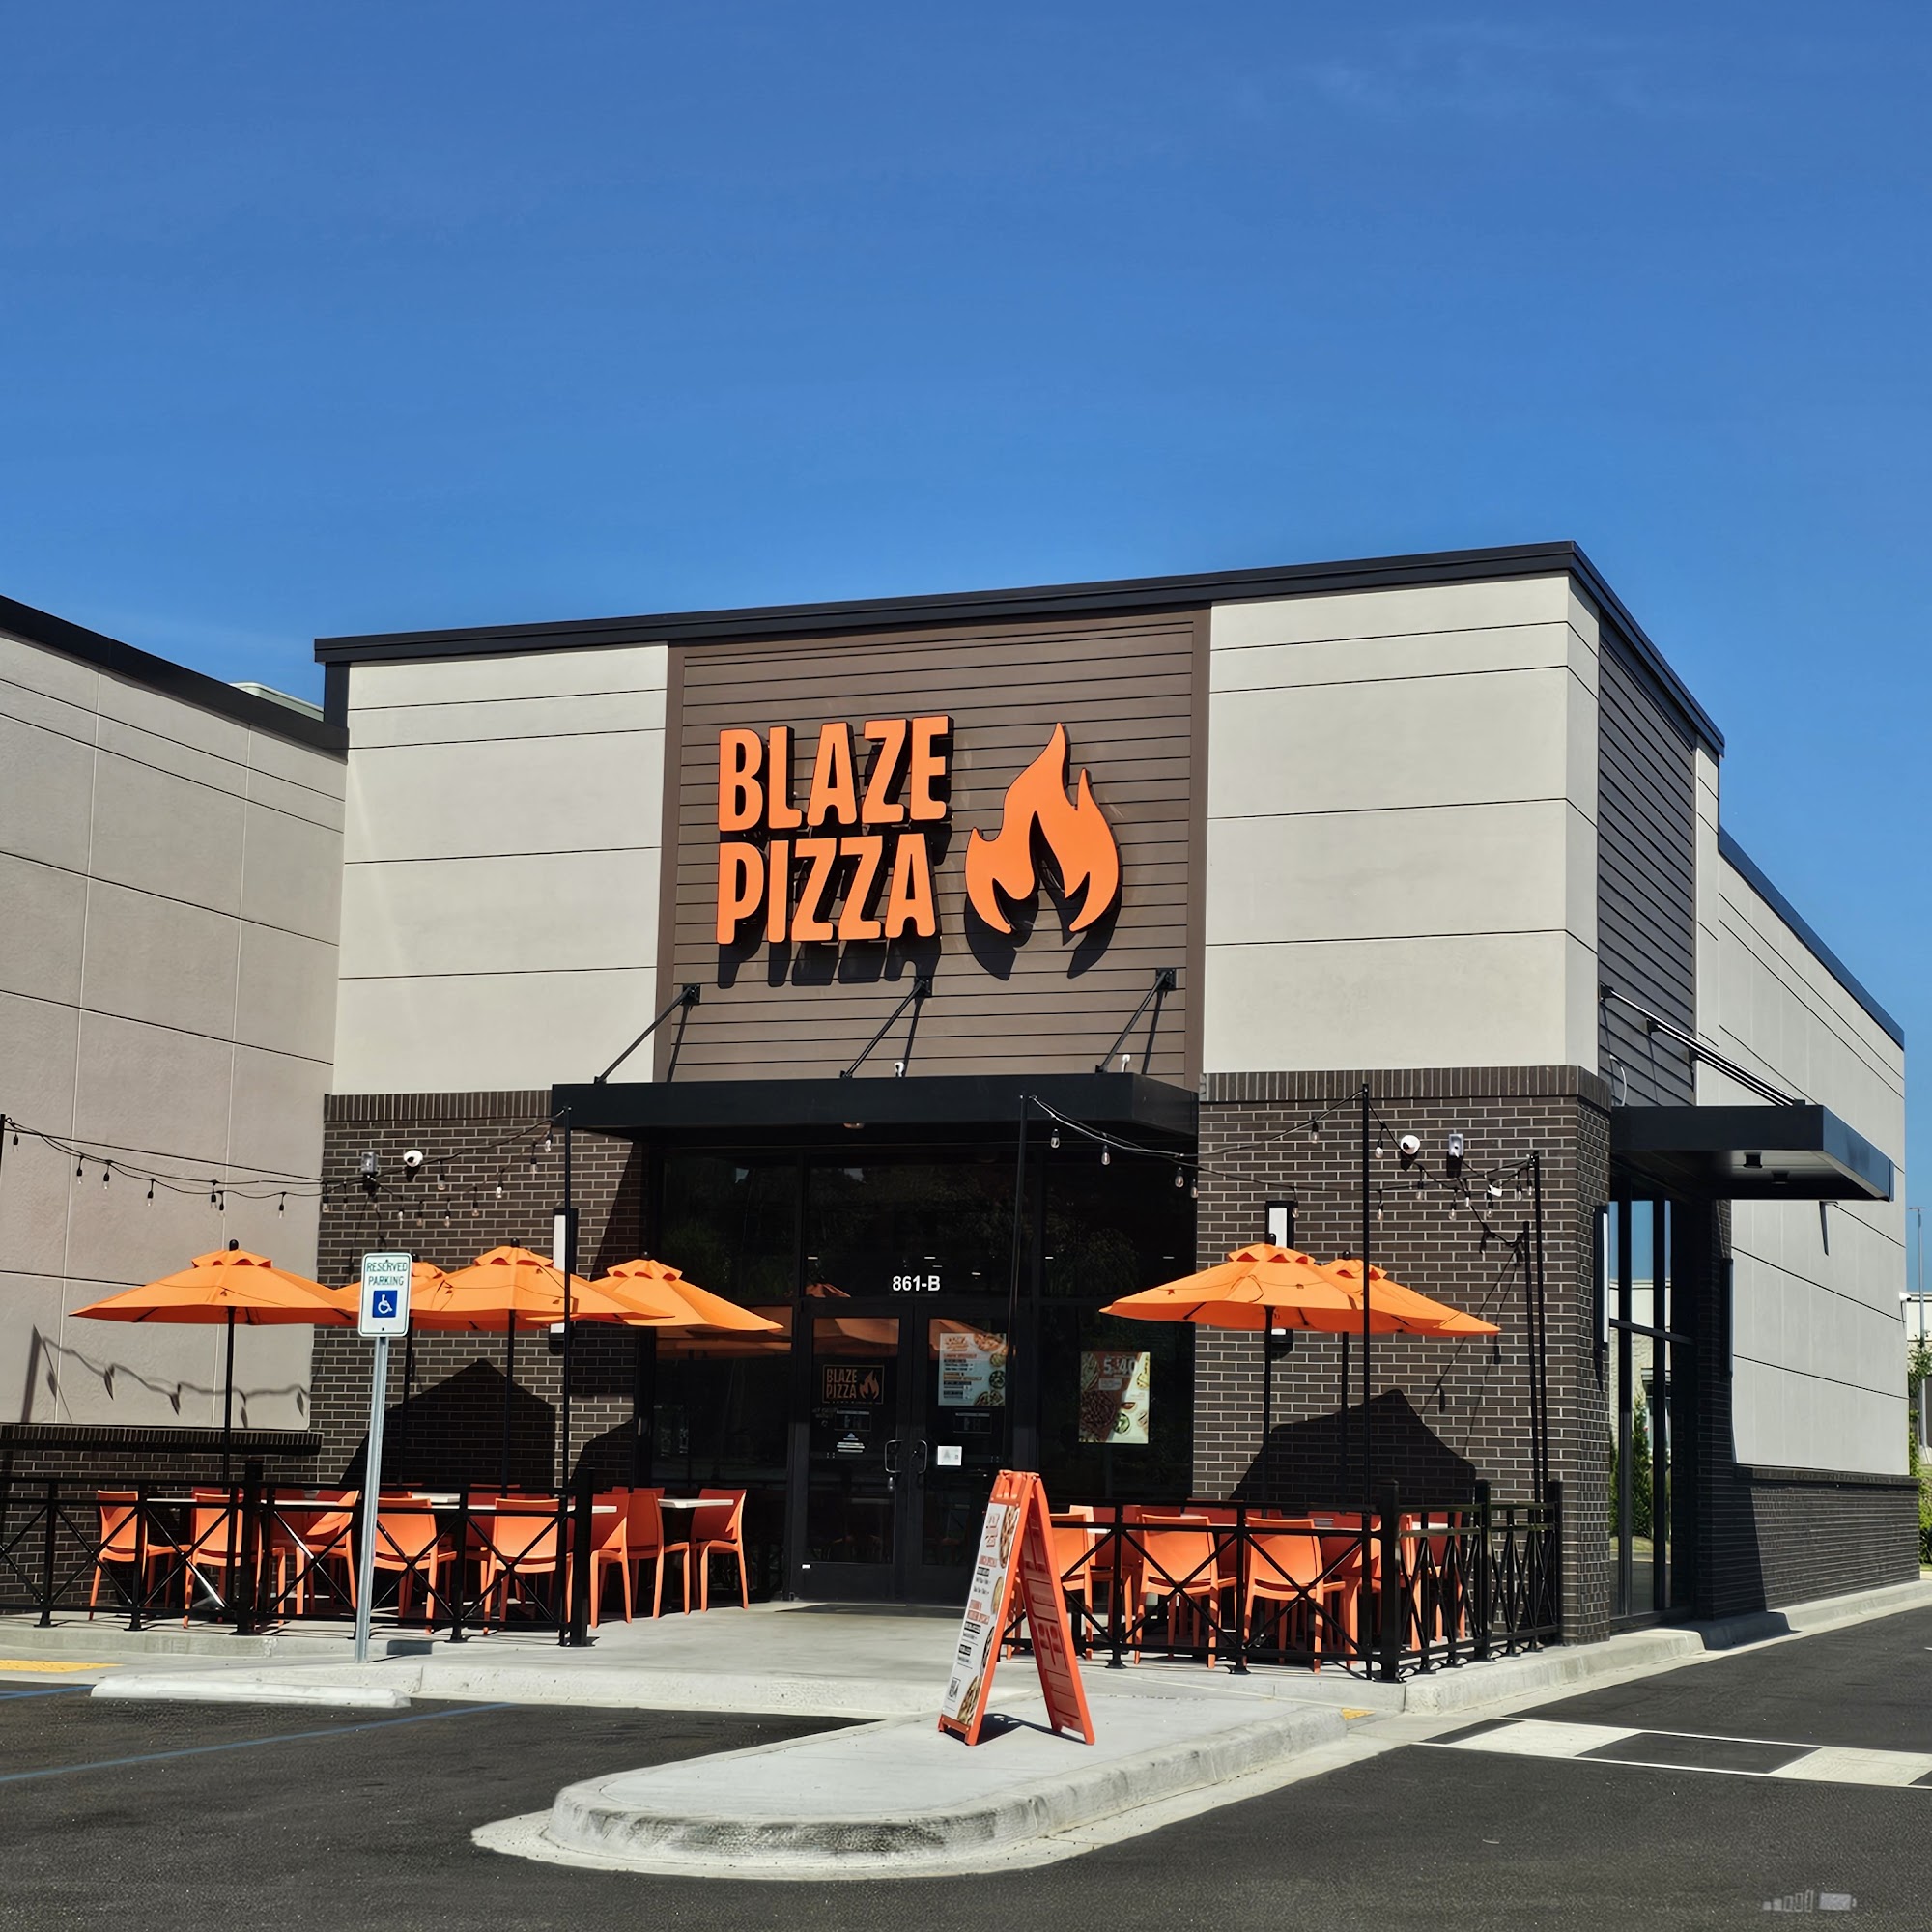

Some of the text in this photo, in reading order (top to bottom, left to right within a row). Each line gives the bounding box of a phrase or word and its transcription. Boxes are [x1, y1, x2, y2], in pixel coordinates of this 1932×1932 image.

[718, 715, 950, 832] BLAZE
[717, 833, 937, 945] PIZZA
[366, 1262, 408, 1272] RESERVED
[368, 1276, 405, 1286] PARKING
[892, 1275, 941, 1292] 861-B
[826, 1368, 858, 1383] BLAZE
[826, 1383, 857, 1399] PIZZA
